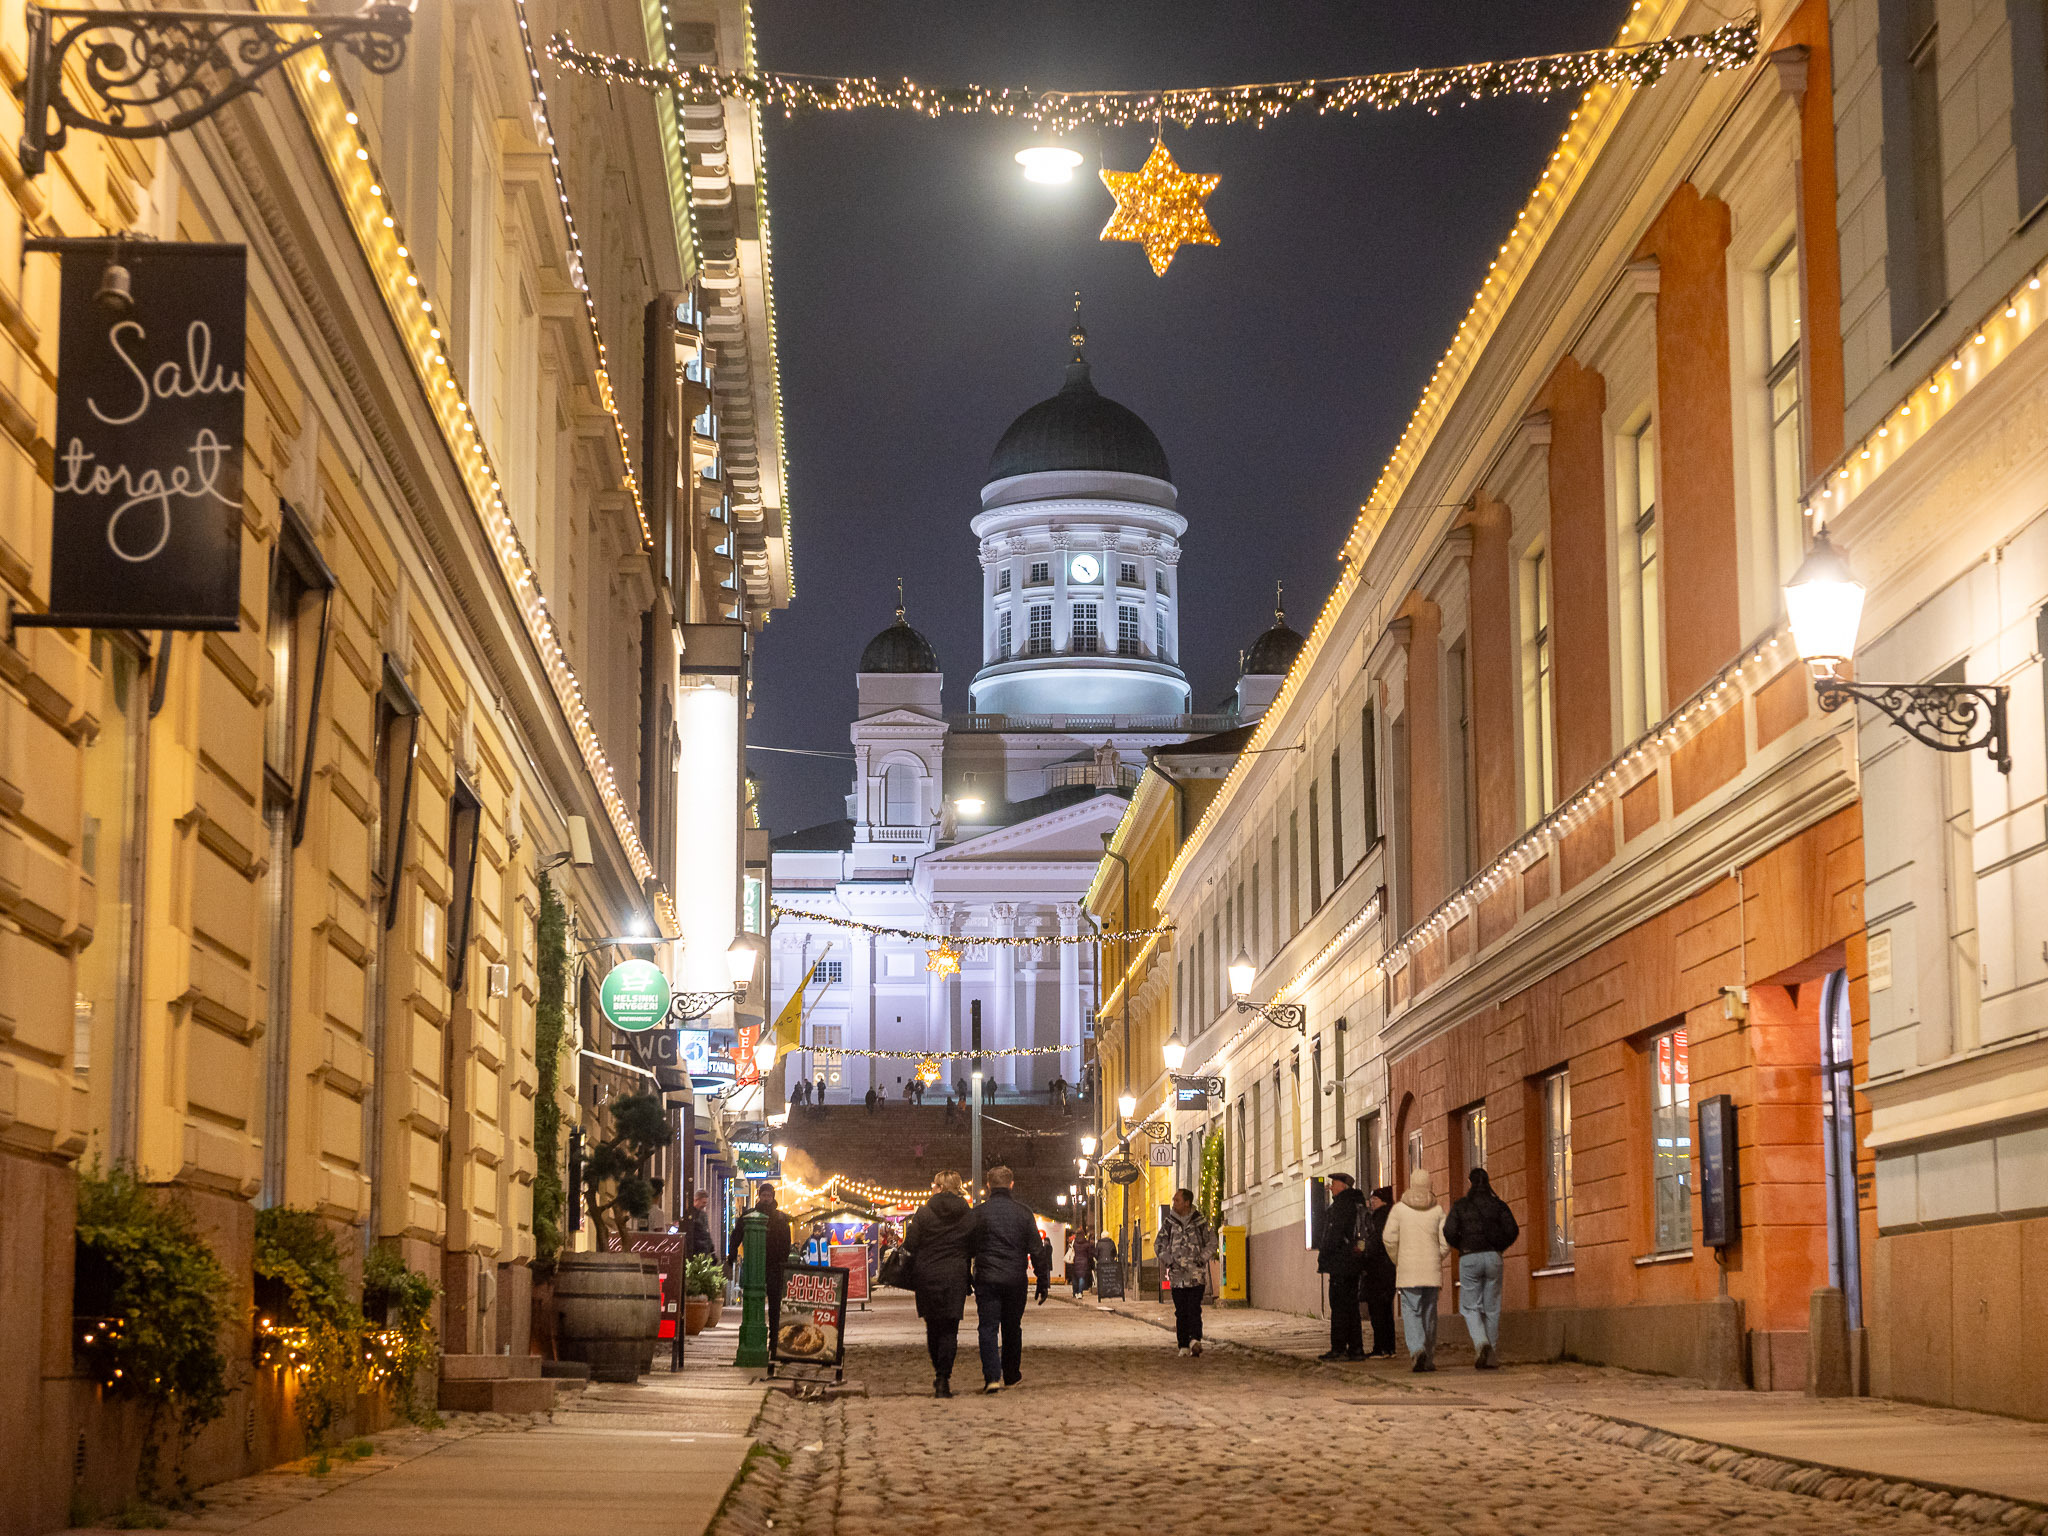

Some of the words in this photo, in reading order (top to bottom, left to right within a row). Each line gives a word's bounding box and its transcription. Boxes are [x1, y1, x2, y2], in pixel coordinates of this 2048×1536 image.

[88, 321, 245, 425] Salu
[54, 428, 242, 562] torget
[613, 994, 658, 1003] HELSINKI
[635, 1035, 671, 1059] WC
[786, 1287, 836, 1304] PUURO
